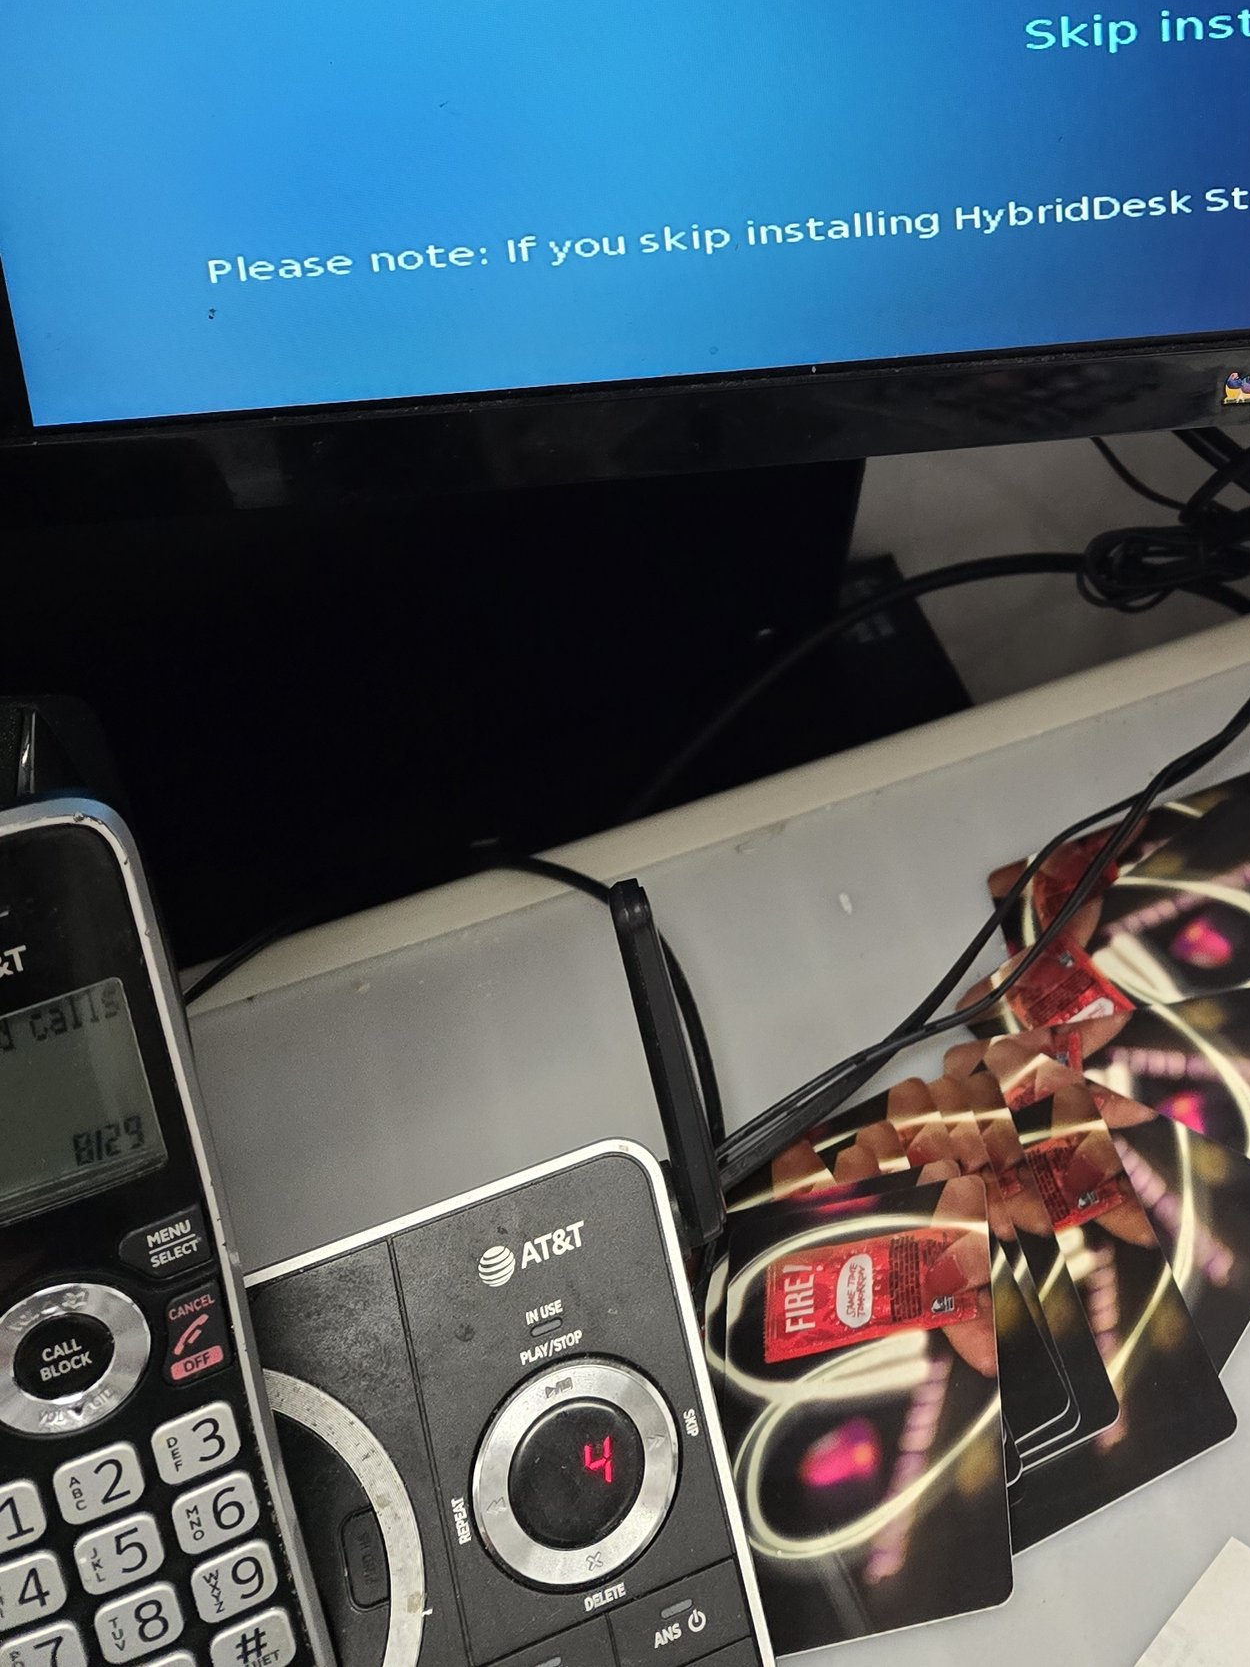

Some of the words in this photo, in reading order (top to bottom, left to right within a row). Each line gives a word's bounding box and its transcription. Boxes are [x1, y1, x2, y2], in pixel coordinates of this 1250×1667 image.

[1025, 13, 1138, 54] Skip
[207, 255, 353, 284] Please
[370, 242, 488, 274] note:
[507, 235, 537, 263] If
[548, 233, 626, 268] you
[639, 223, 731, 255] skip
[747, 206, 940, 246] installing
[955, 189, 1193, 235] HybridDesk
[146, 1219, 191, 1248] MENU
[150, 1239, 199, 1268] SELECT
[521, 1220, 585, 1270] AT&T
[168, 1293, 215, 1321] CANCEL
[526, 1311, 539, 1325] IN
[541, 1299, 563, 1319] USE
[785, 1265, 823, 1333] FIRE!
[39, 1352, 93, 1382] BLOCK
[41, 1338, 83, 1362] CALL
[183, 1352, 212, 1374] OFF
[519, 1329, 583, 1365] PLAY/STOP
[192, 1417, 226, 1462] 3
[683, 1408, 700, 1437] SKIP
[584, 1435, 613, 1483] 4
[94, 1458, 131, 1505] 2
[0, 1496, 35, 1541] 1
[212, 1486, 245, 1530] 6
[450, 1497, 472, 1545] REPEAT
[114, 1527, 148, 1573] 5
[18, 1567, 50, 1608] 4
[231, 1556, 265, 1600] 9
[584, 1582, 627, 1611] DELETE
[134, 1599, 169, 1643] 8
[654, 1623, 682, 1649] ANS
[33, 1636, 64, 1667] 7
[235, 1627, 267, 1664] #
